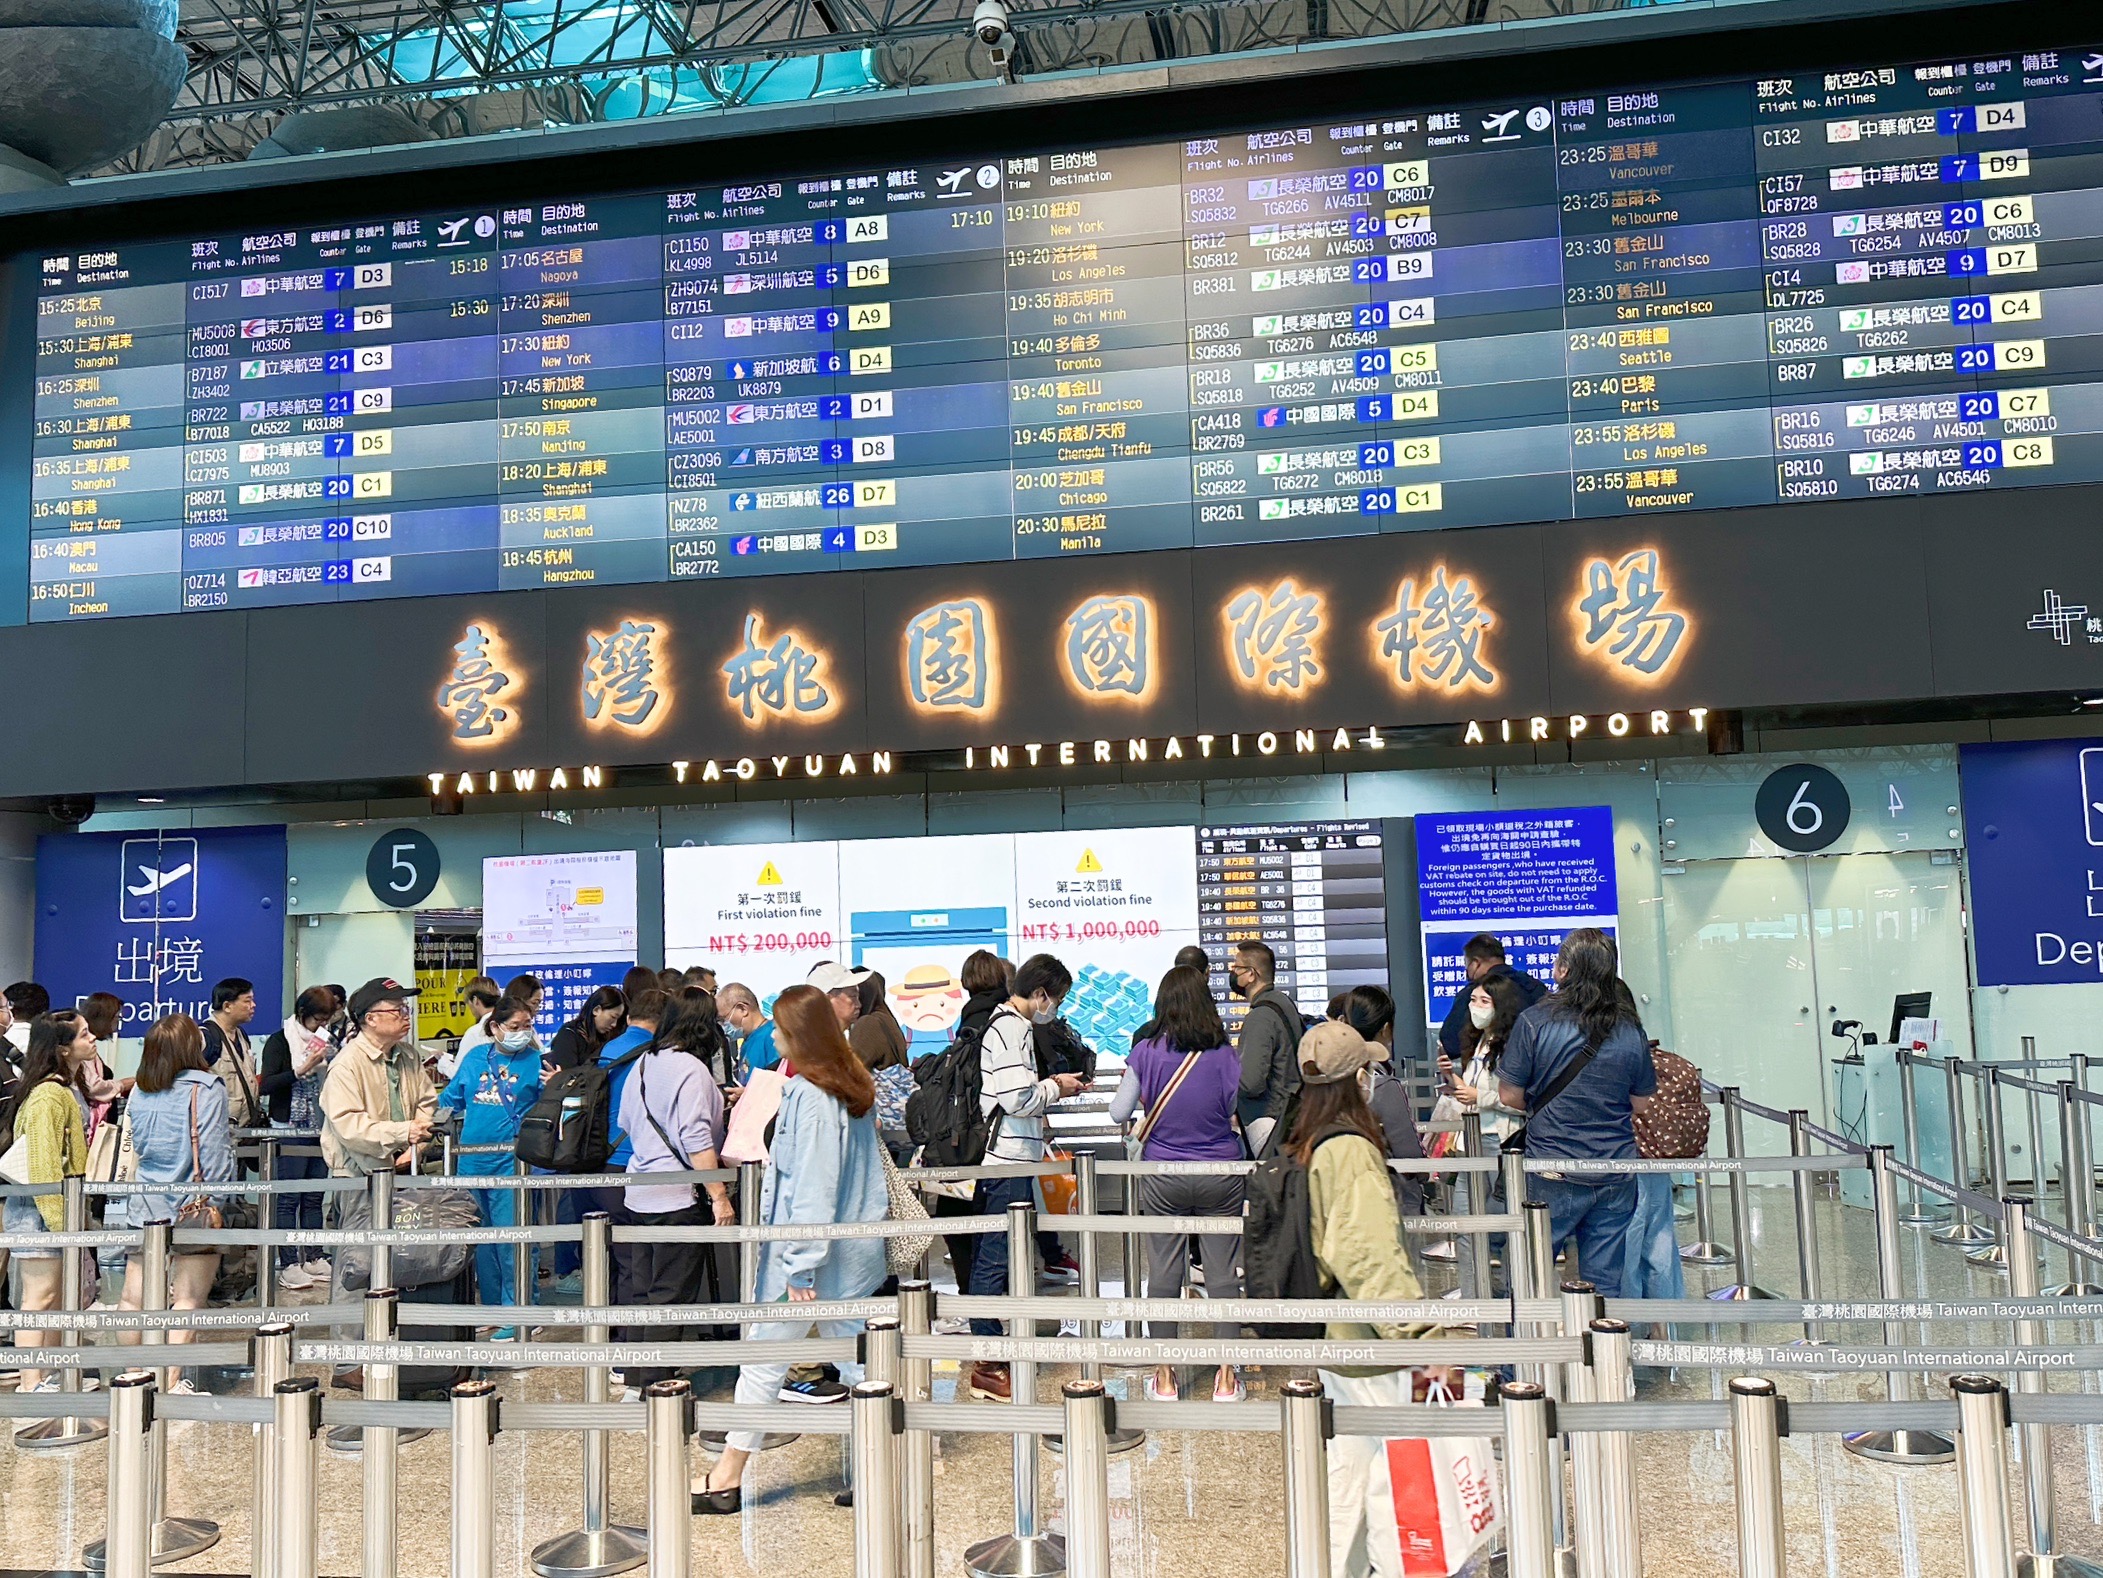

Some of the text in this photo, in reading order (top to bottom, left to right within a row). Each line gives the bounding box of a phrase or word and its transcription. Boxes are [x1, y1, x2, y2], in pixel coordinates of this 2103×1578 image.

[984, 169, 991, 185] 2
[43, 257, 69, 273] 時間
[78, 252, 118, 269] 目的地
[192, 241, 218, 257] 班次
[242, 232, 297, 252] 航空公司
[392, 219, 420, 236] 備註
[501, 210, 992, 269] 17:05 名古屋 CI150 中華航空 8 A8 17:10
[42, 239, 427, 286] Time Destination Flight No. Airlines Gate Remarks
[40, 258, 488, 315] 15:25 北京 CI517 中華航空 7 D3 15:18
[541, 271, 578, 283] Nagoya
[1009, 258, 1421, 312] 19:35 胡志明市 BR381 長榮航空 20 B9
[76, 315, 115, 328] Beijing
[1053, 308, 1126, 327] Ho Chi Minh
[1570, 299, 2030, 351] 23:40 西雅圖 BR26 長榮航空 20 C4
[502, 309, 880, 353] 17:30 紐約 CI12 中華航空 9 A9
[1620, 330, 1908, 366] Seattle TG6262
[542, 353, 591, 368] New York
[1572, 347, 2034, 398] 23:40 巴黎 BR87 長榮航空 20 C9
[1621, 398, 1660, 413] Paris
[1017, 491, 1430, 535] 20:30 馬尼拉 BR261 長榮航空 20 C1
[33, 520, 388, 559] 16:40 澳門 BR805 長榮航空 20 C10
[1061, 536, 1101, 550] Manila
[69, 562, 98, 573] Macau
[438, 548, 1688, 740] 臺灣桃園國際機場
[428, 707, 1708, 797] TAIWAN TAOYUAN INTERNATIONAL AIRPORT
[1786, 781, 1823, 834] 6
[389, 843, 417, 892] 5
[1200, 858, 1220, 867] 17:50
[1428, 864, 1461, 872] Foreign
[1463, 862, 1510, 871] passengers
[1556, 858, 1594, 866] received
[1574, 867, 1597, 876] apply
[1028, 894, 1152, 908] Second violation fine
[1431, 907, 1457, 915] within
[1459, 906, 1469, 914] 90
[1472, 905, 1491, 915] days
[1517, 904, 1531, 912] the
[1533, 903, 1572, 913] purchase
[718, 906, 822, 920] First violation fine
[1023, 920, 1159, 941] NT$ 1,000,000
[710, 932, 831, 953] NT$ 200,000
[115, 936, 203, 985] 出境
[395, 1213, 421, 1222] BON
[100, 1314, 138, 1326] Taiwan
[141, 1314, 188, 1329] Taoyuan
[192, 1312, 264, 1326] International
[268, 1312, 310, 1324] Airport
[1106, 1302, 1479, 1321] 臺灣桃園國際機場 Taiwan Taoyuan International Airport
[299, 1345, 662, 1363] 臺灣桃園國際機場 Taiwan Taoyuan International Airport
[971, 1341, 1375, 1363] 臺灣桃園國際機場 Taiwan Taoyuan International Airport
[1767, 1348, 1826, 1364] Taiwan
[1830, 1349, 1898, 1368] Taoyuan
[1903, 1350, 2010, 1366] International
[2014, 1350, 2075, 1369] Airport
